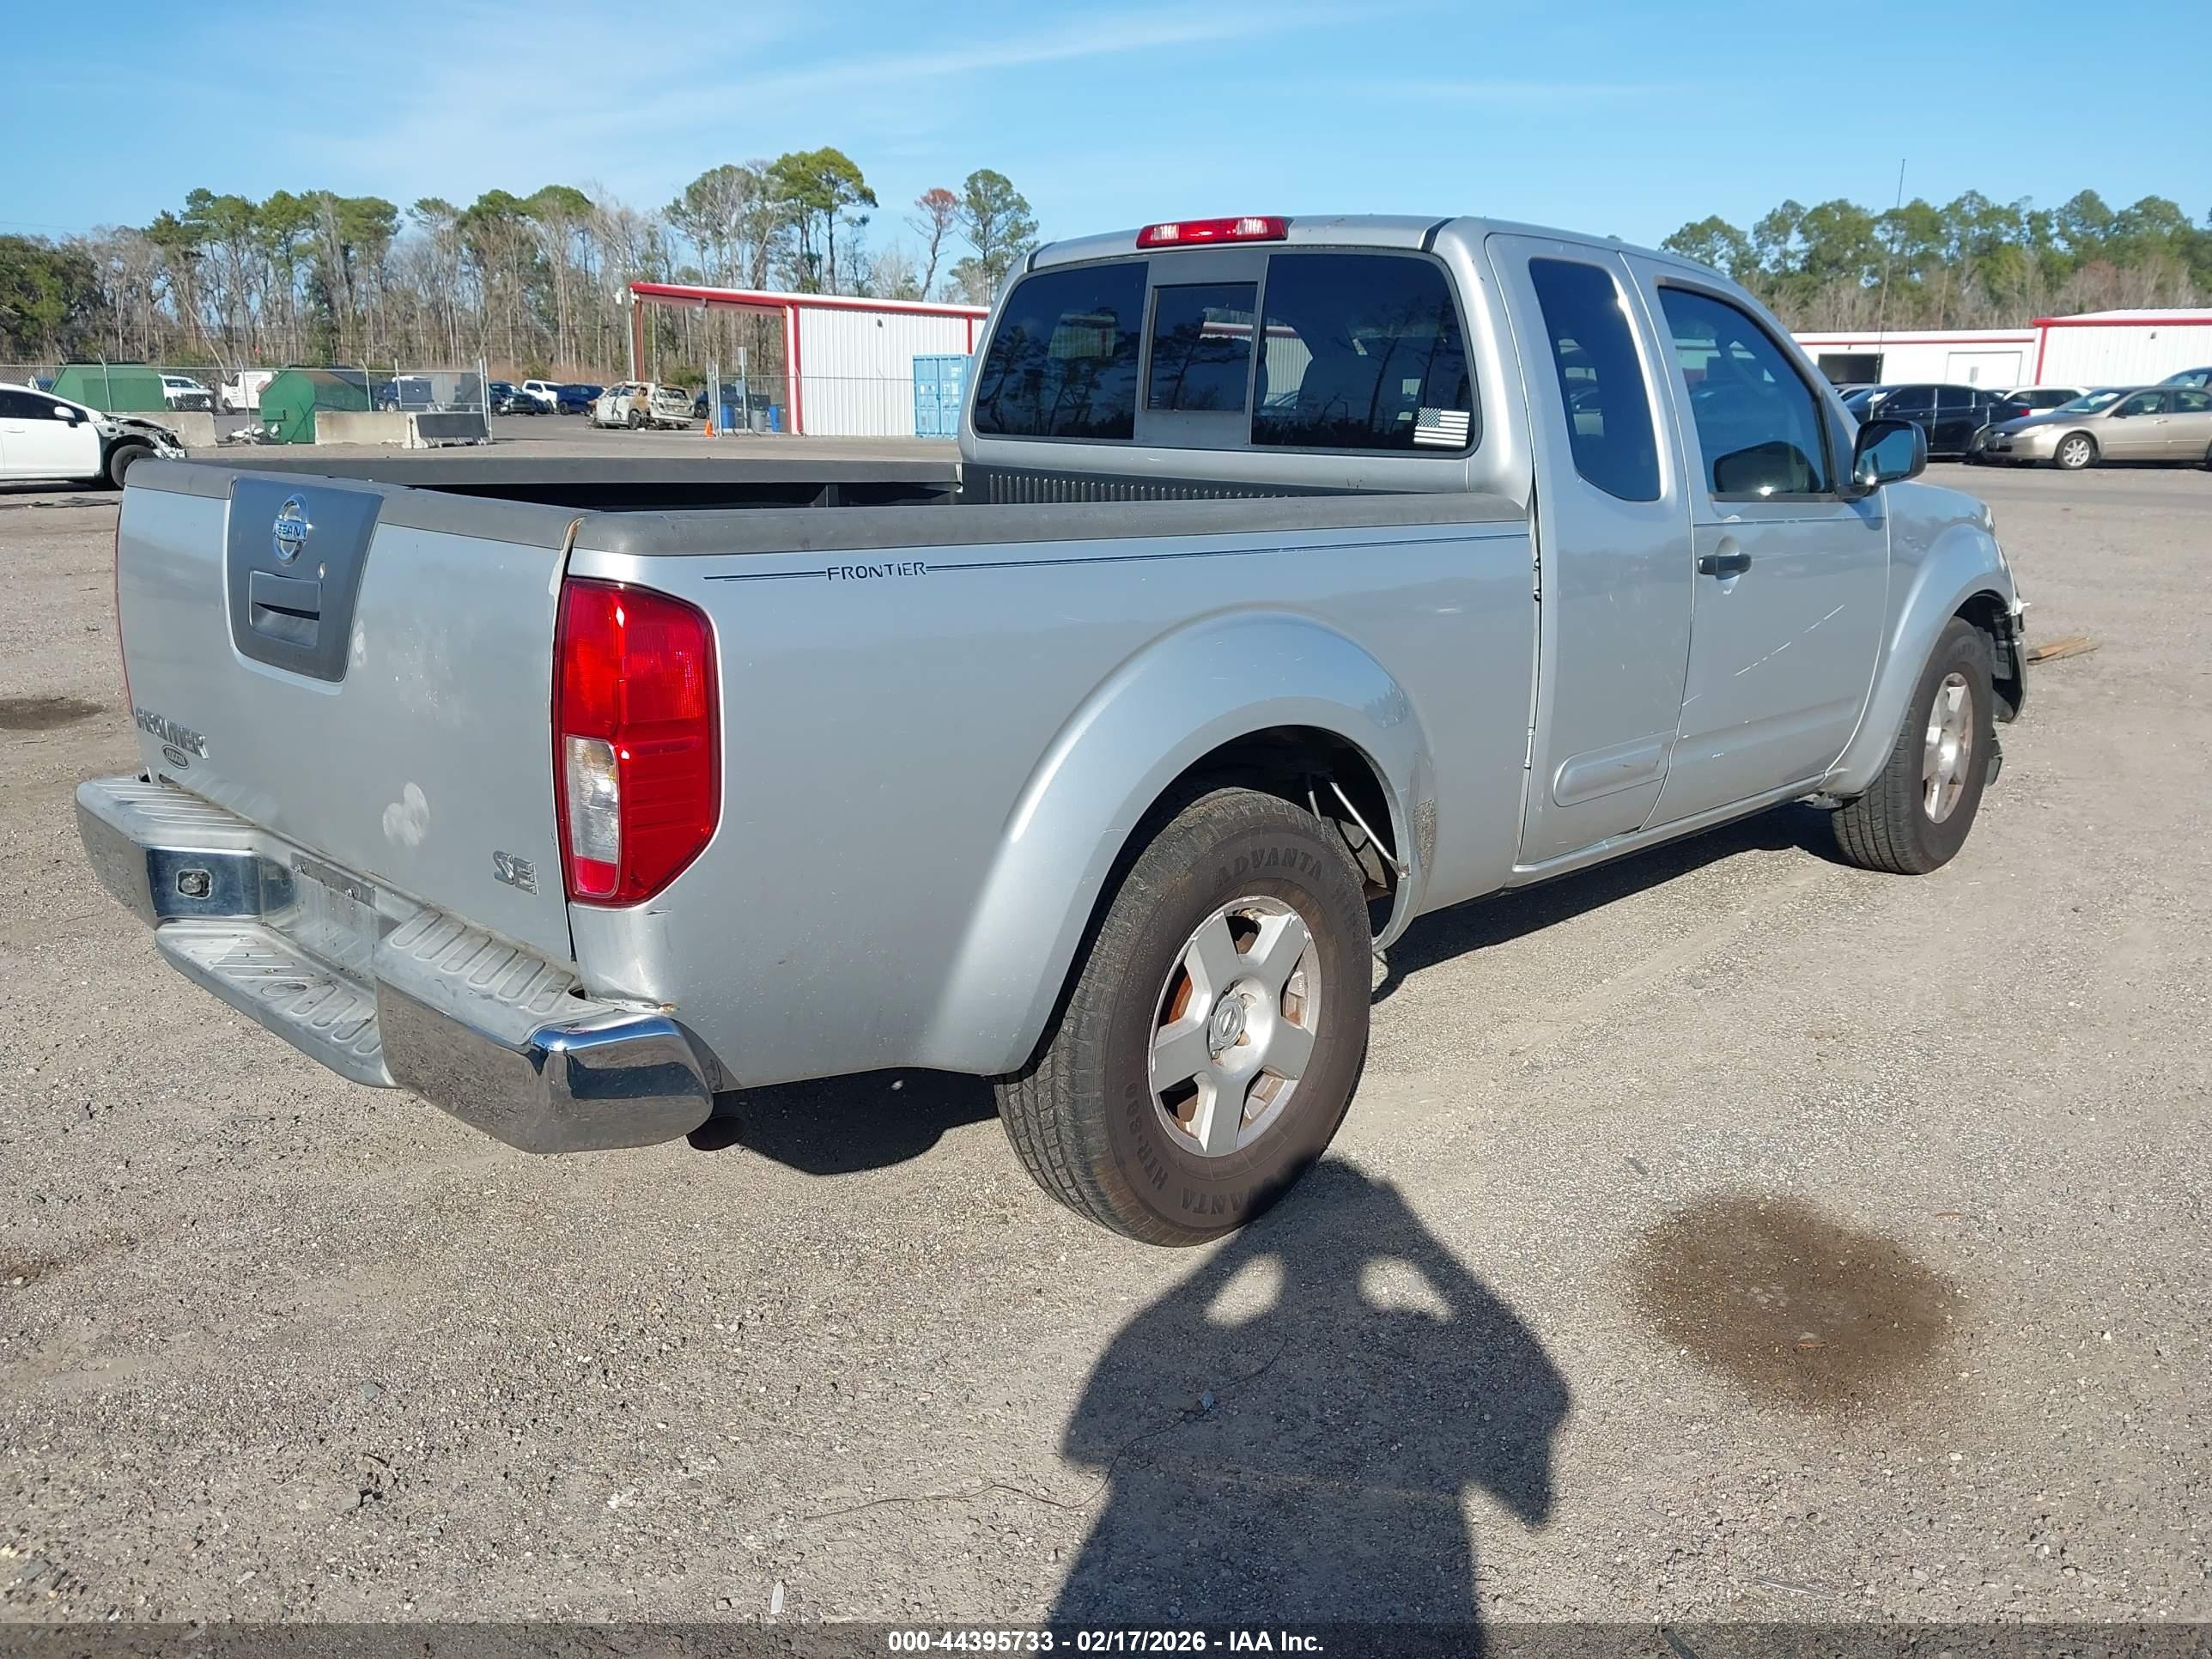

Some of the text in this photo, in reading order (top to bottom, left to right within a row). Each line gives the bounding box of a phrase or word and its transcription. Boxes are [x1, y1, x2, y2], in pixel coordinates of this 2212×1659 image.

[826, 562, 927, 580] FRONTIER
[493, 850, 538, 895] SE
[1215, 846, 1323, 890] ADVANTA
